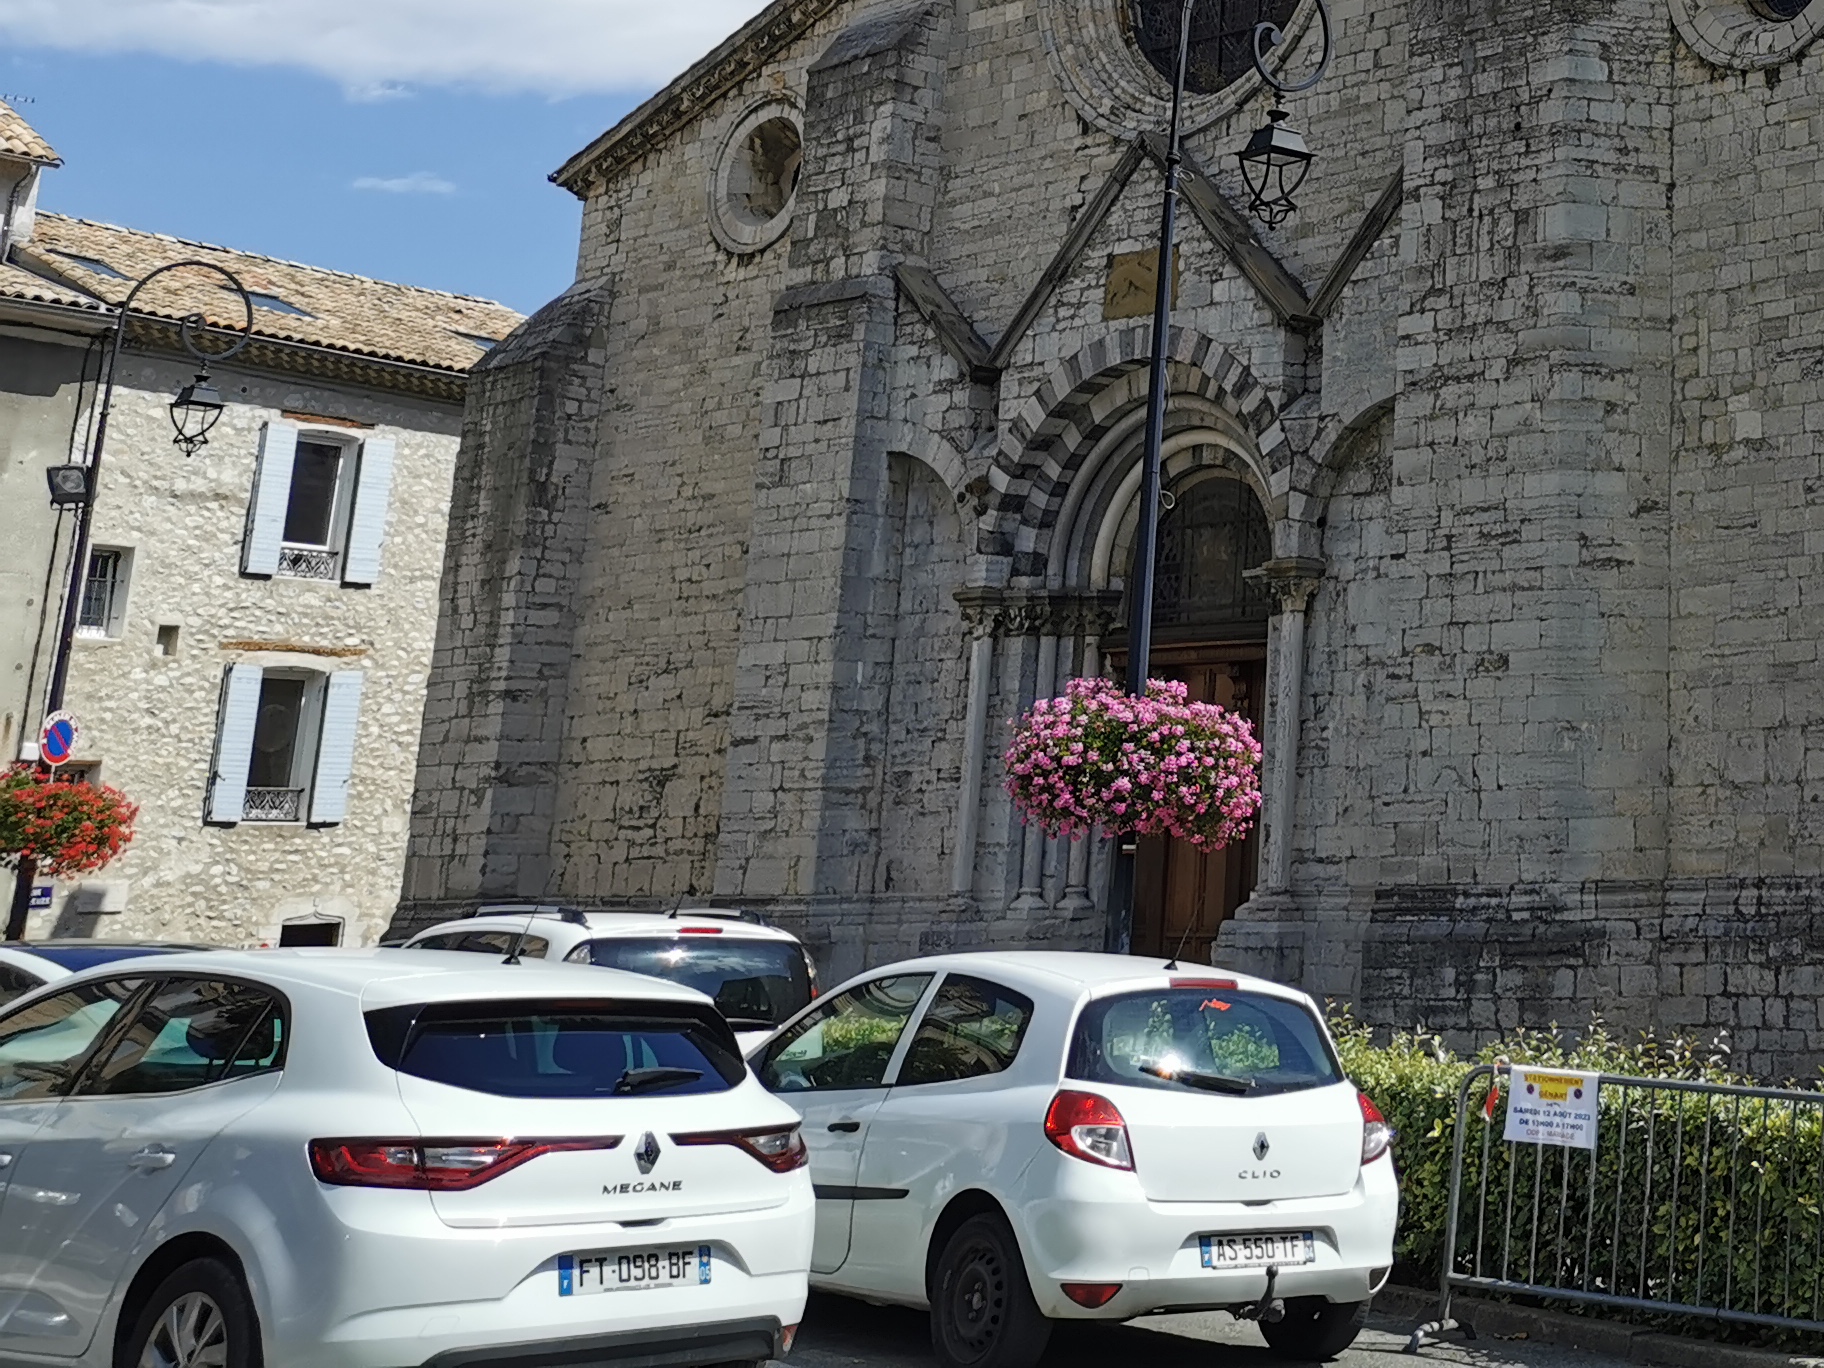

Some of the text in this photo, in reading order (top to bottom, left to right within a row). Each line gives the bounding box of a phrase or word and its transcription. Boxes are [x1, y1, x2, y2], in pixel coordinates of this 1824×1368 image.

[1513, 1106, 1540, 1116] SAMEDI
[1573, 1112, 1591, 1121] 2023
[1518, 1118, 1529, 1126] DE
[1238, 1169, 1281, 1179] CLIO
[602, 1180, 683, 1195] MEGANE
[1216, 1235, 1300, 1262] AS-550-TF
[579, 1250, 694, 1288] FT-098-BF
[700, 1266, 711, 1281] 05
